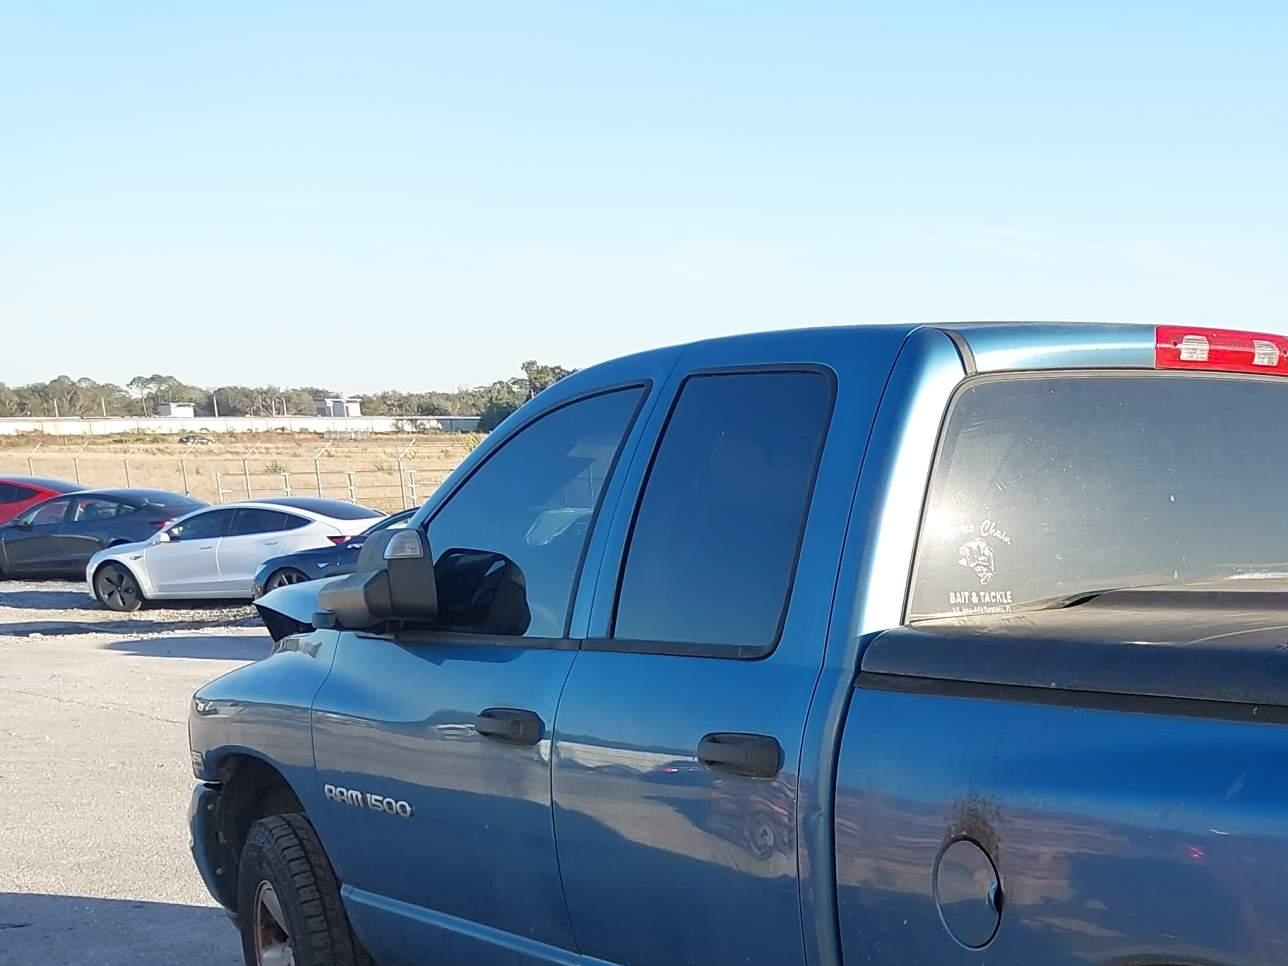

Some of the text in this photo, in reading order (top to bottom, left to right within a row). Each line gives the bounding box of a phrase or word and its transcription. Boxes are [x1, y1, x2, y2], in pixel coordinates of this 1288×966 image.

[949, 590, 1013, 604] BAIT & TACKLE
[324, 783, 412, 818] RAM 1500
